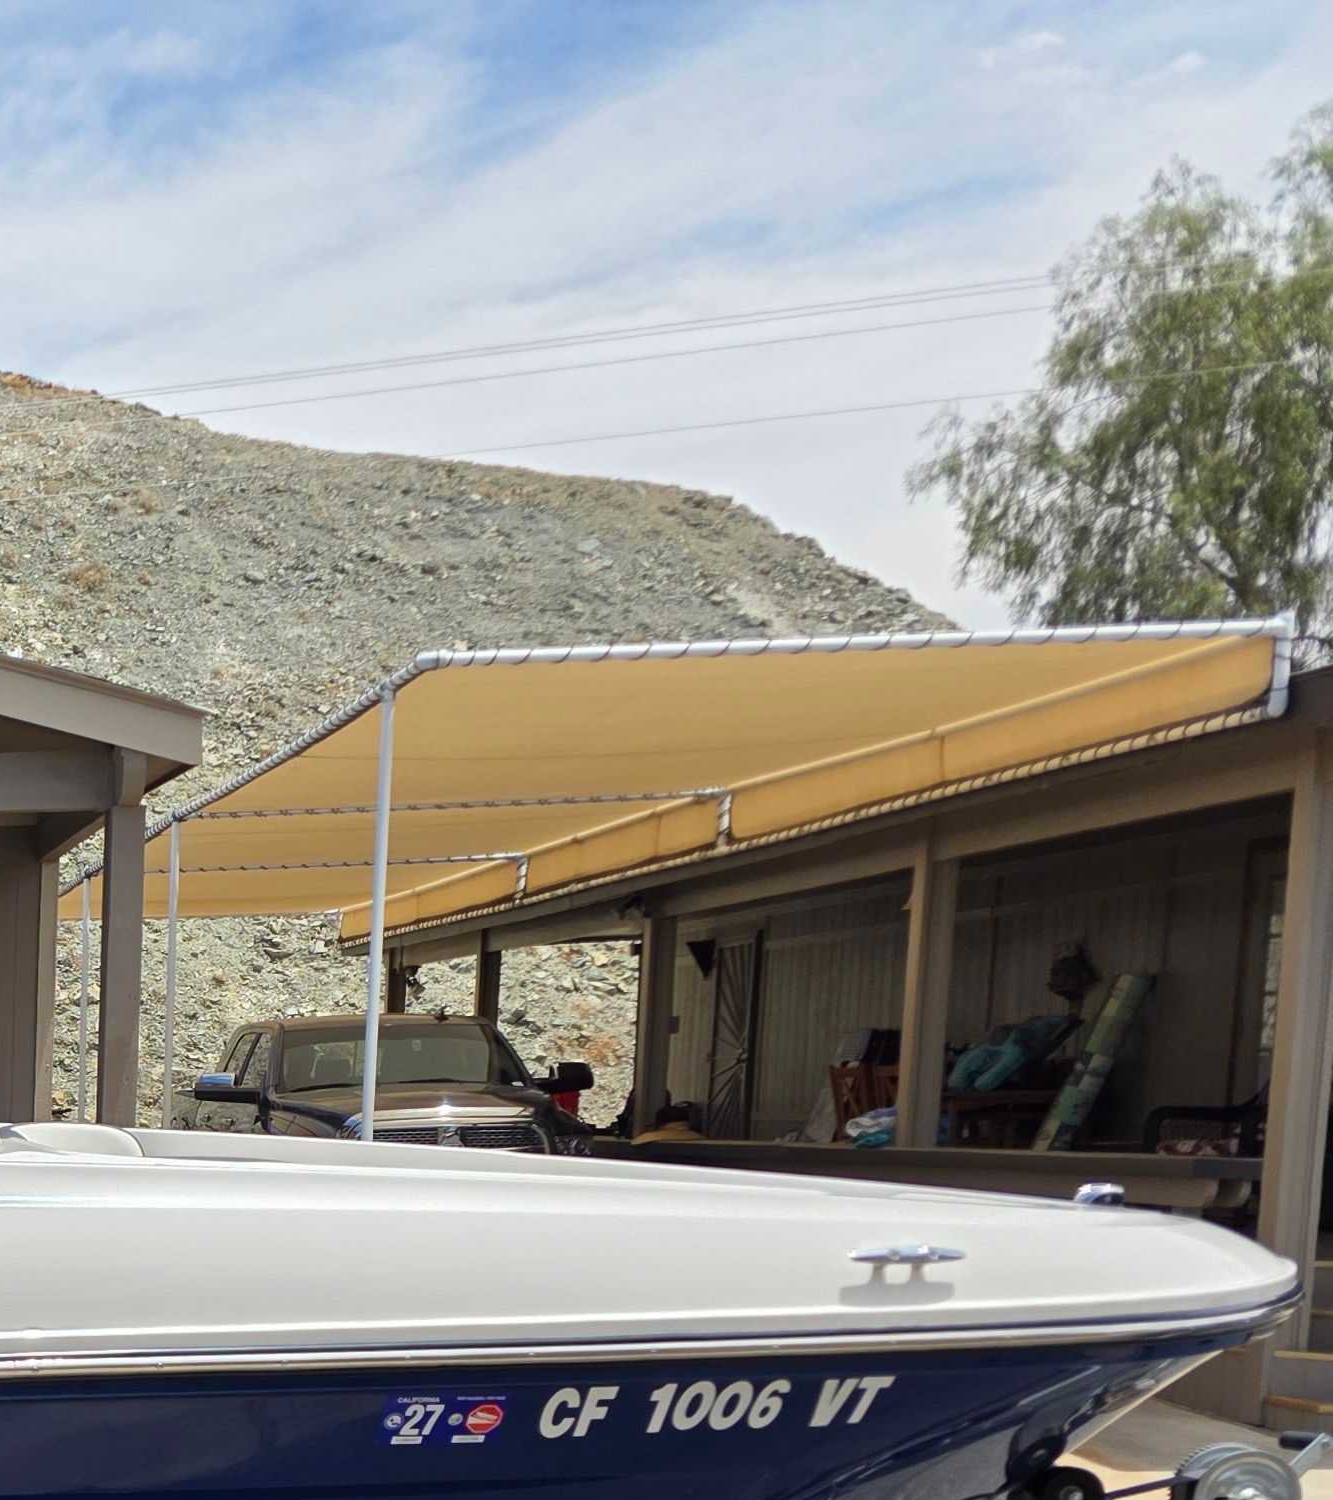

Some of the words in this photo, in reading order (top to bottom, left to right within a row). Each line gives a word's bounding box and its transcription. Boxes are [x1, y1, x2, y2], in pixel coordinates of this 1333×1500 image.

[399, 1404, 445, 1435] 27
[539, 1386, 620, 1438] CF
[646, 1380, 792, 1433] 1006
[808, 1376, 896, 1427] VT
